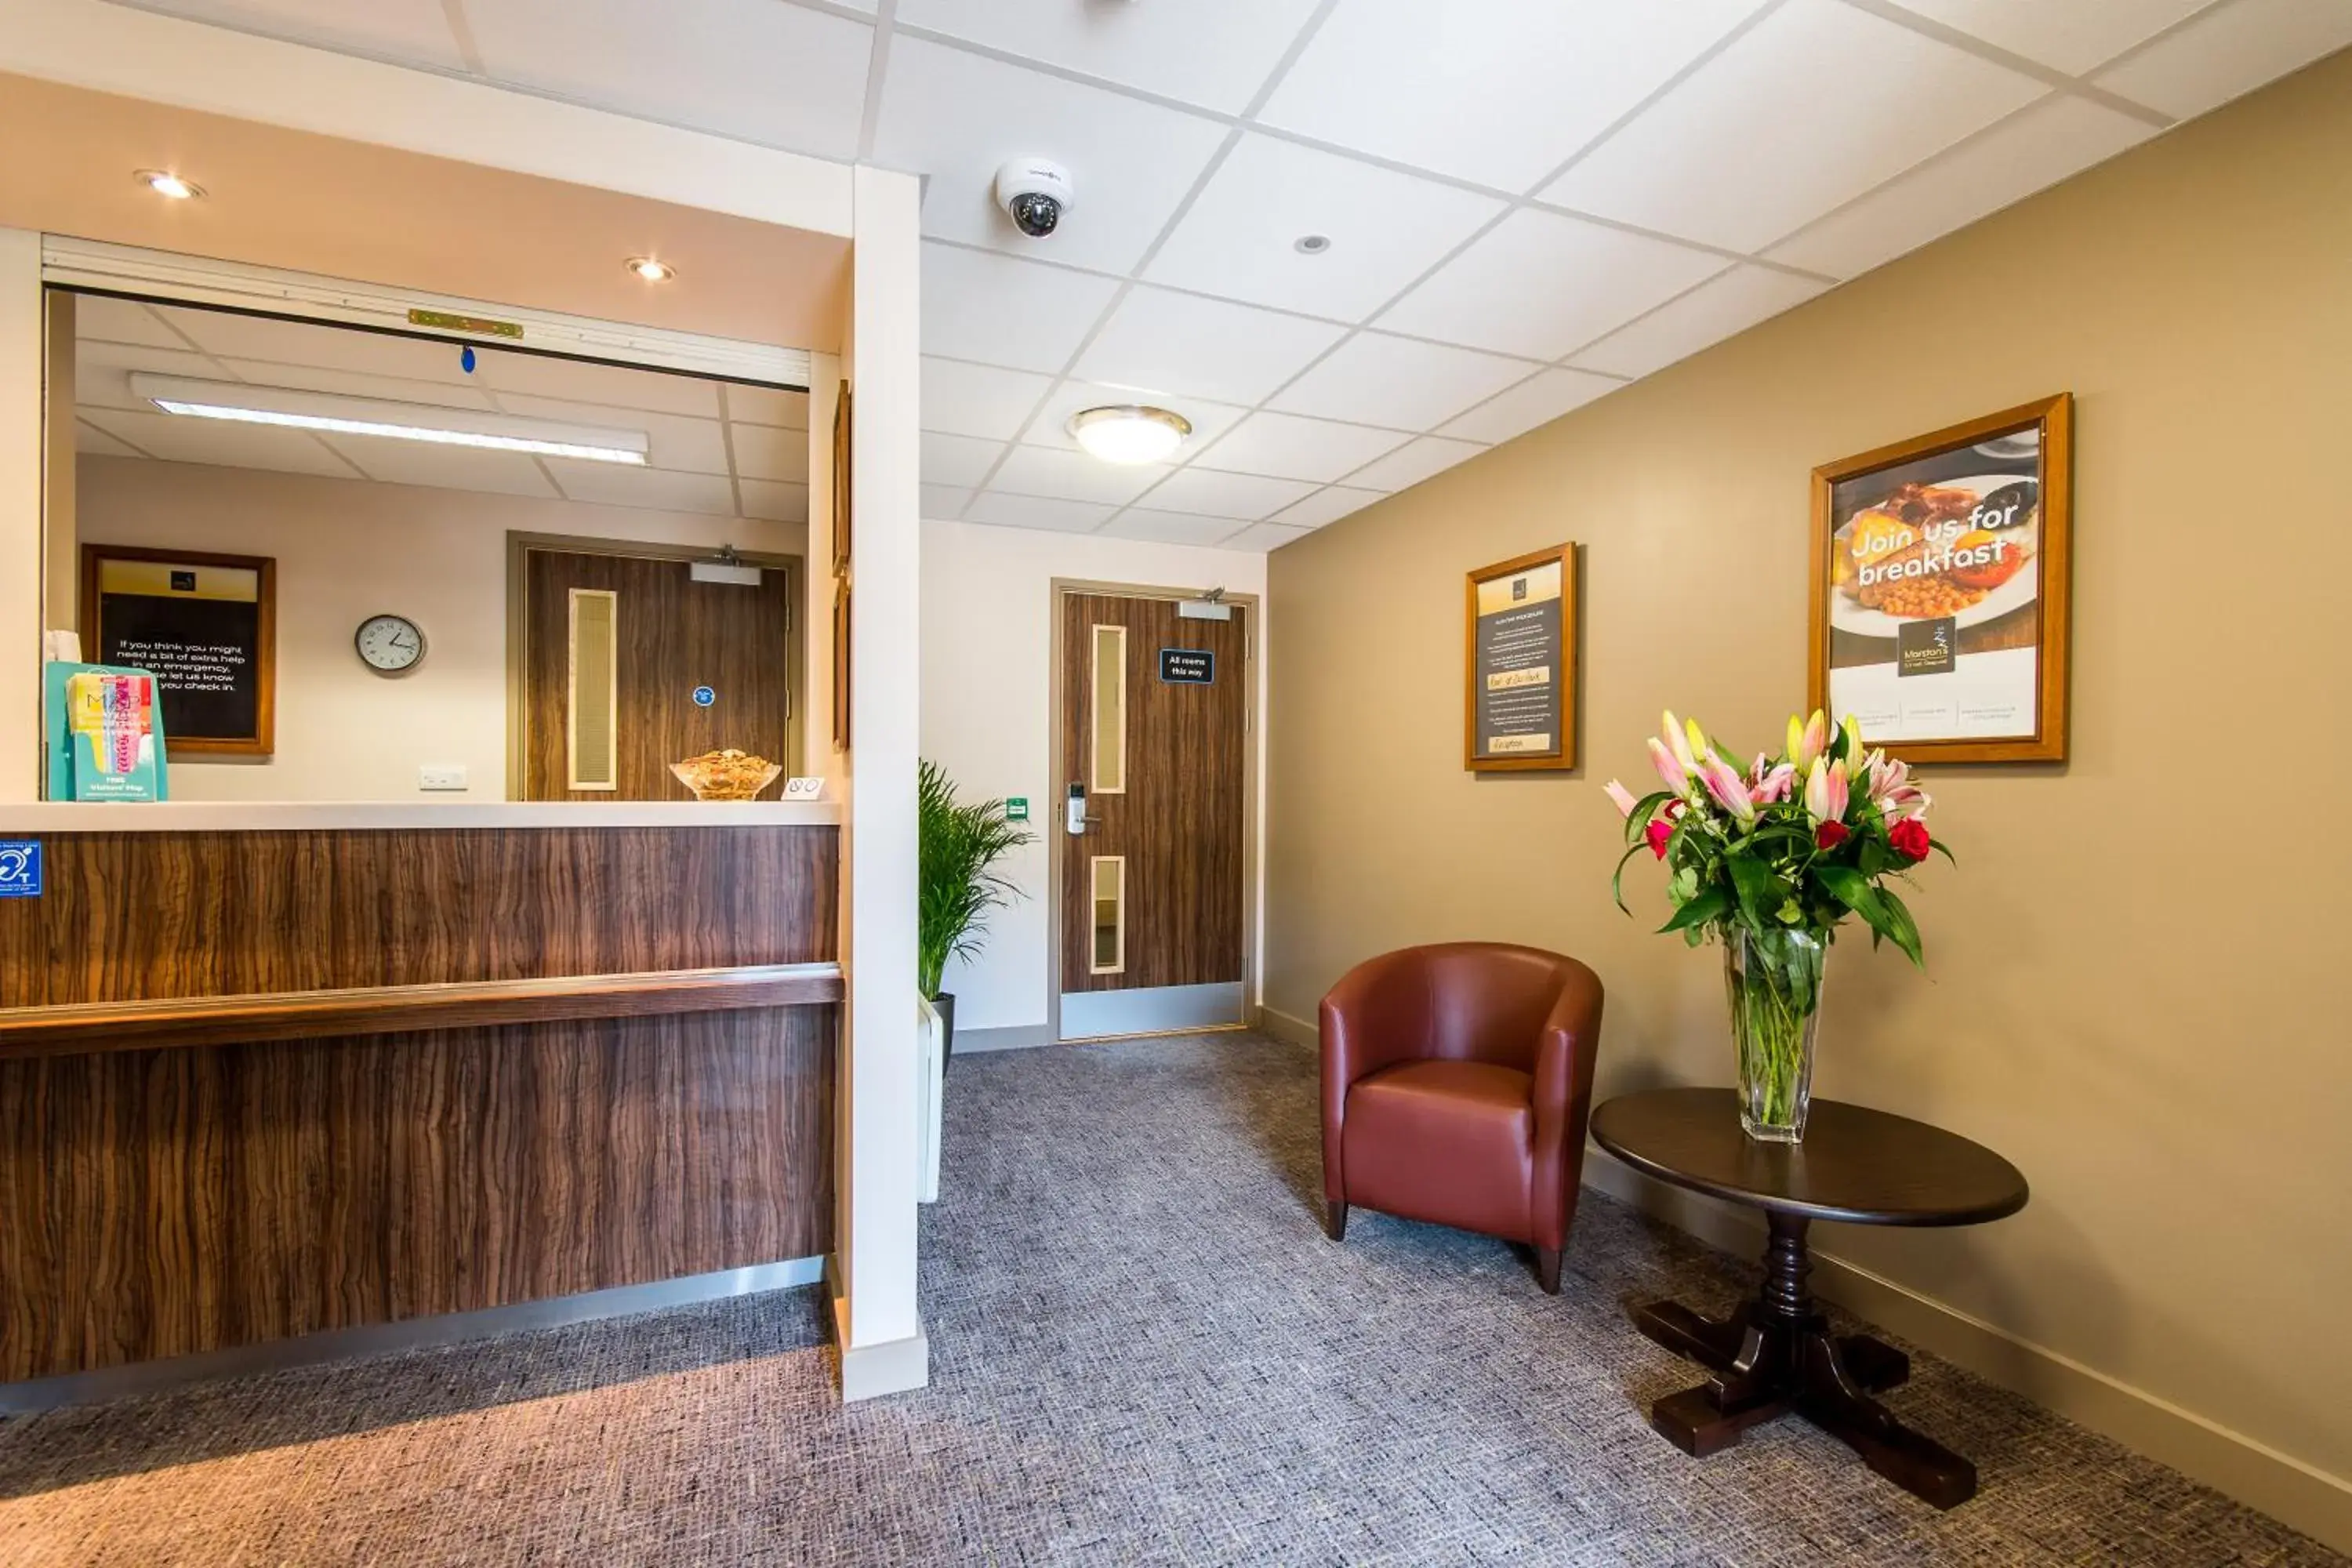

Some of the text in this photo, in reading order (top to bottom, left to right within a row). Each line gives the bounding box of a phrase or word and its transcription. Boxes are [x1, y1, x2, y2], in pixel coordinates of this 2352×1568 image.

[1851, 504, 2019, 557] Join us for
[1859, 539, 2008, 587] breakfast
[120, 640, 128, 648] If
[154, 642, 183, 651] think
[209, 645, 242, 655] might
[191, 654, 219, 662] extra
[220, 655, 245, 664] help
[1169, 656, 1206, 666] All rooms
[164, 663, 230, 673] emergency,
[1171, 667, 1204, 678] this way
[203, 673, 234, 682] know
[184, 682, 220, 691] check
